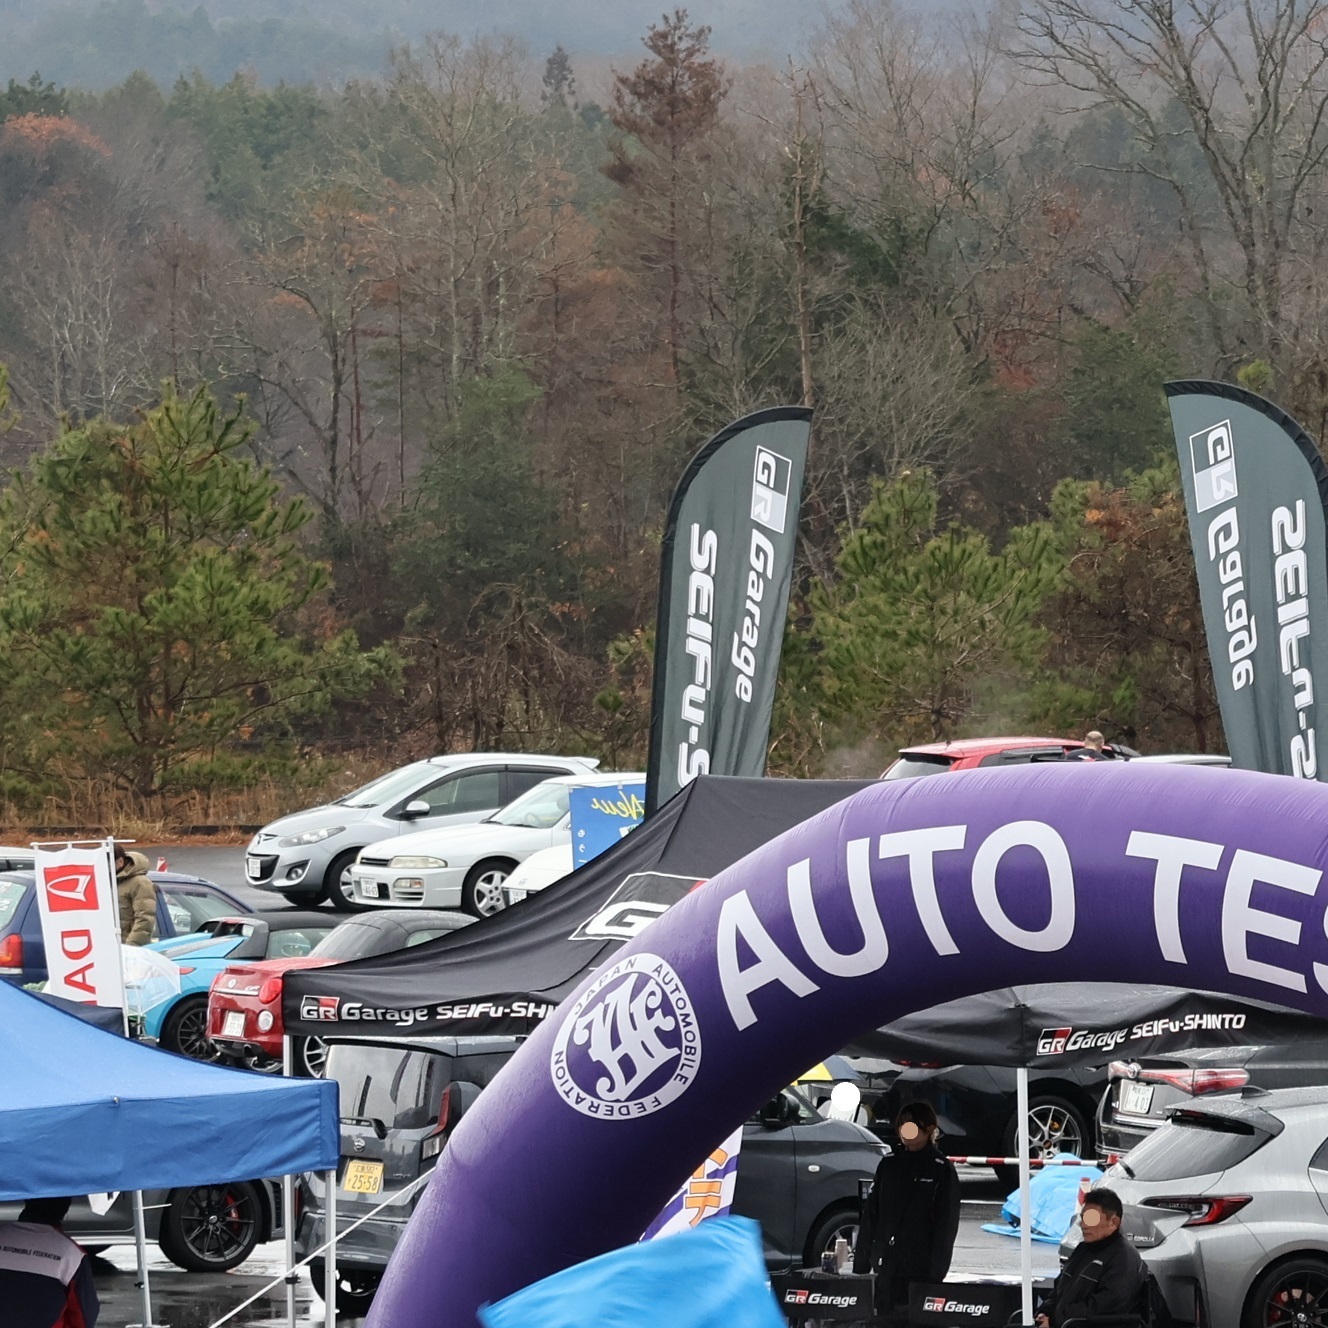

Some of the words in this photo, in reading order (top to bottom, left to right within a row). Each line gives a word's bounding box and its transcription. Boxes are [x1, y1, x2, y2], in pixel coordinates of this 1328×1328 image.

[752, 450, 777, 525] GR
[731, 528, 775, 703] Garage
[715, 819, 1076, 1031] AUTO
[302, 1005, 336, 1020] GR
[340, 1002, 429, 1026] Garage
[574, 957, 637, 1015] JAPAN
[652, 963, 697, 1086] AUTOMOBILE
[1038, 1038, 1065, 1053] GR
[1066, 1028, 1129, 1052] Garage
[554, 1050, 662, 1117] FEDERATION
[808, 1293, 858, 1308] Garage
[944, 1300, 990, 1317] Garage
